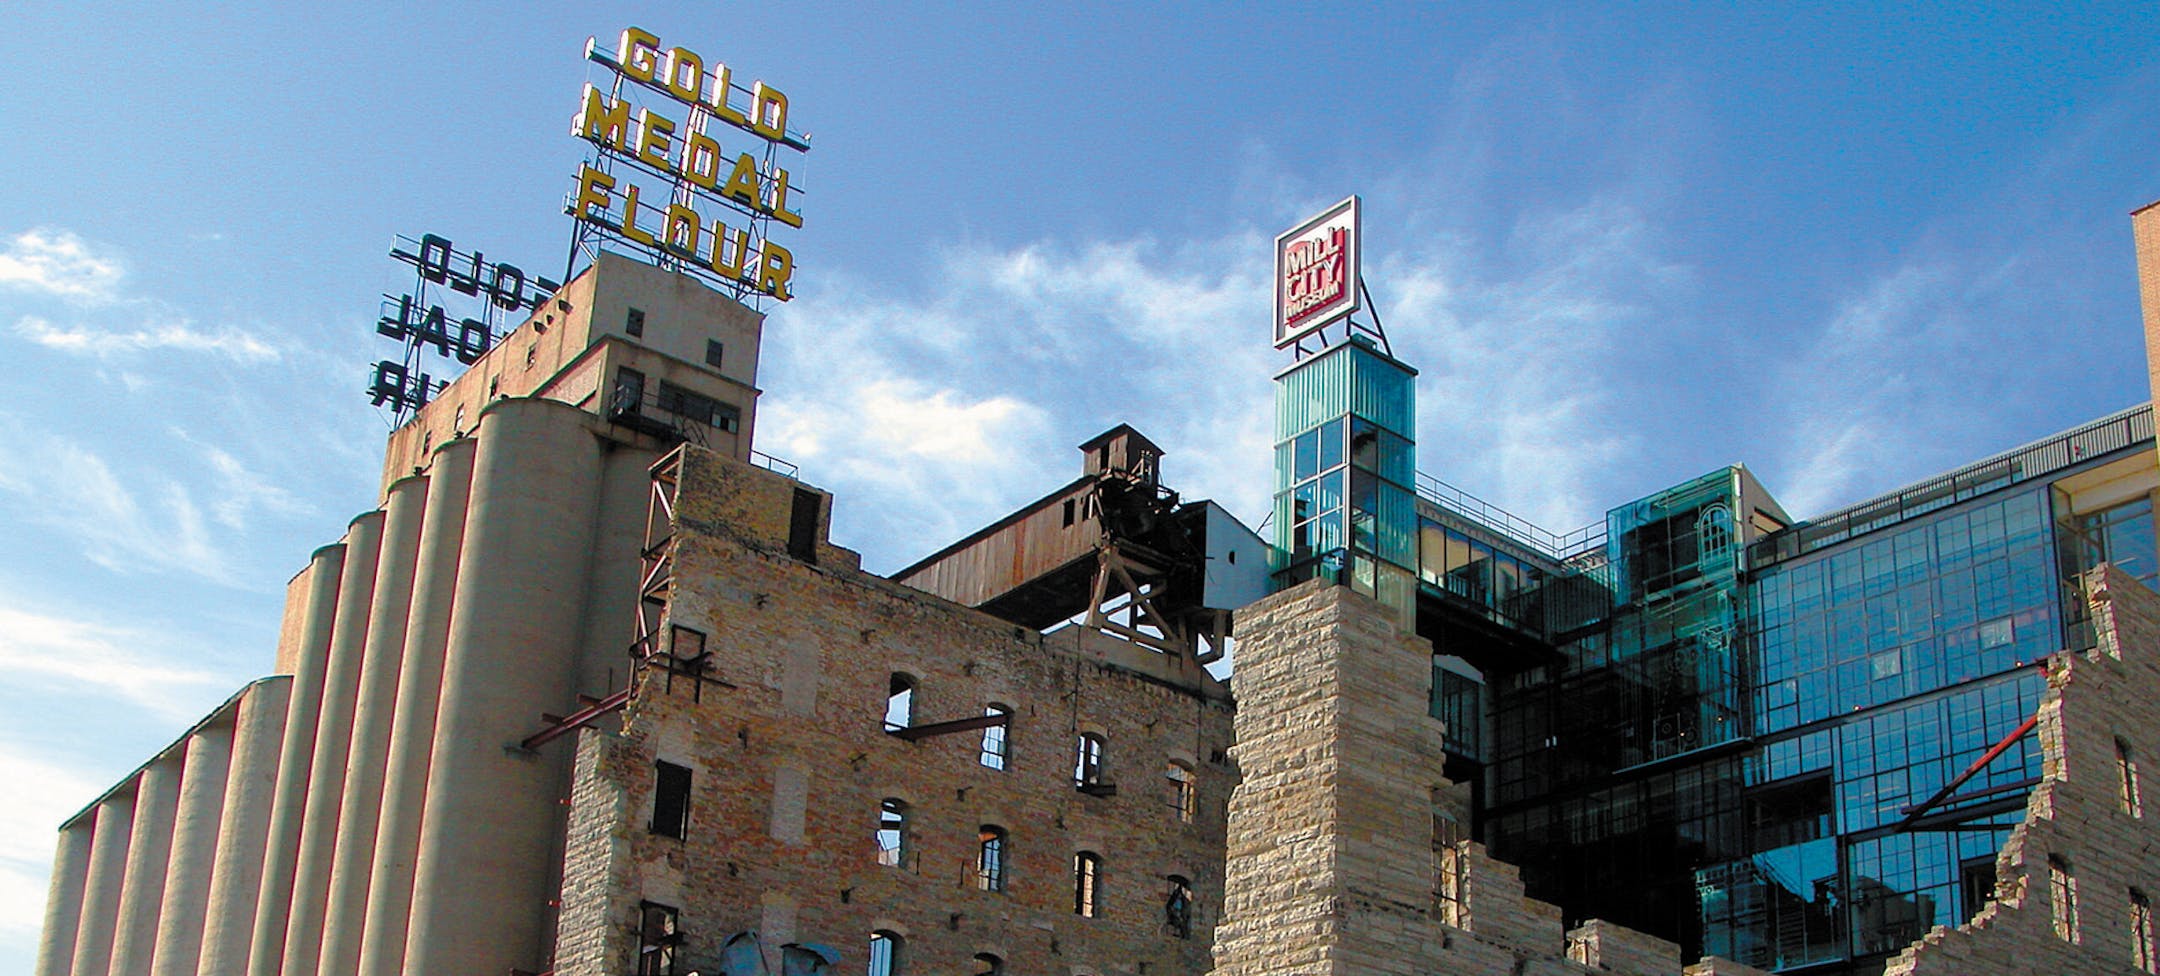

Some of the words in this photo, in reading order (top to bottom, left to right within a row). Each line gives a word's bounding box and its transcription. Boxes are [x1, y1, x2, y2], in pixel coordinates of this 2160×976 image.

[619, 27, 788, 140] GOLD
[581, 82, 803, 229] MEDAL
[576, 163, 793, 303] FLOUR
[1286, 226, 1340, 276] MILL
[1286, 254, 1339, 301] CITY
[1286, 281, 1340, 318] MUSEUM
